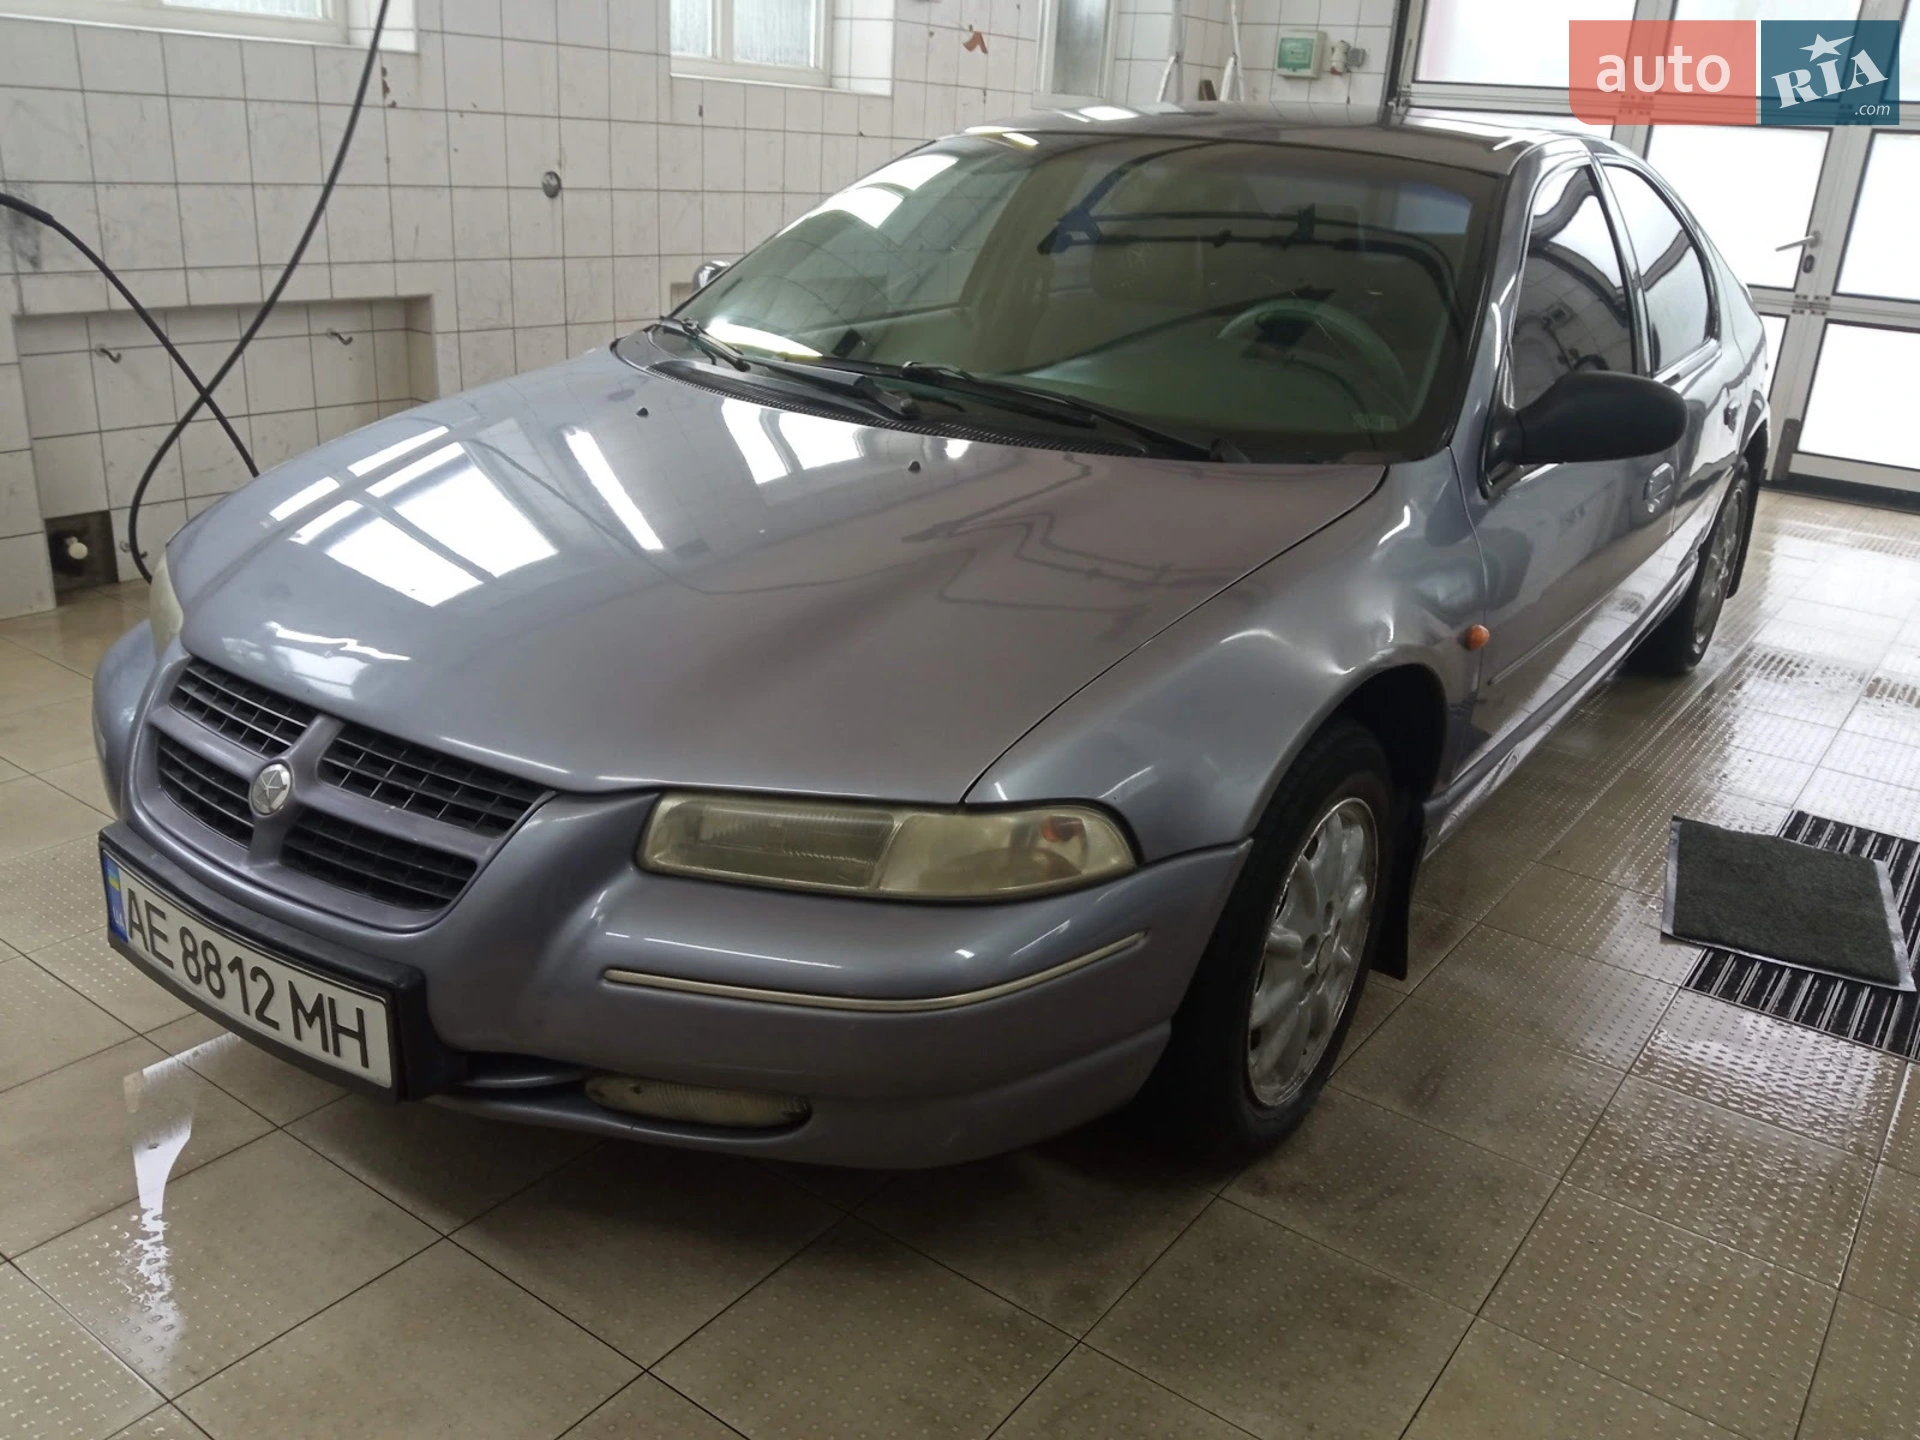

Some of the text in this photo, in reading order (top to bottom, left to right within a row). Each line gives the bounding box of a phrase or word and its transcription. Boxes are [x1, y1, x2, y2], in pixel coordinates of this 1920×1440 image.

[127, 887, 369, 1069] AE 8812 MH
